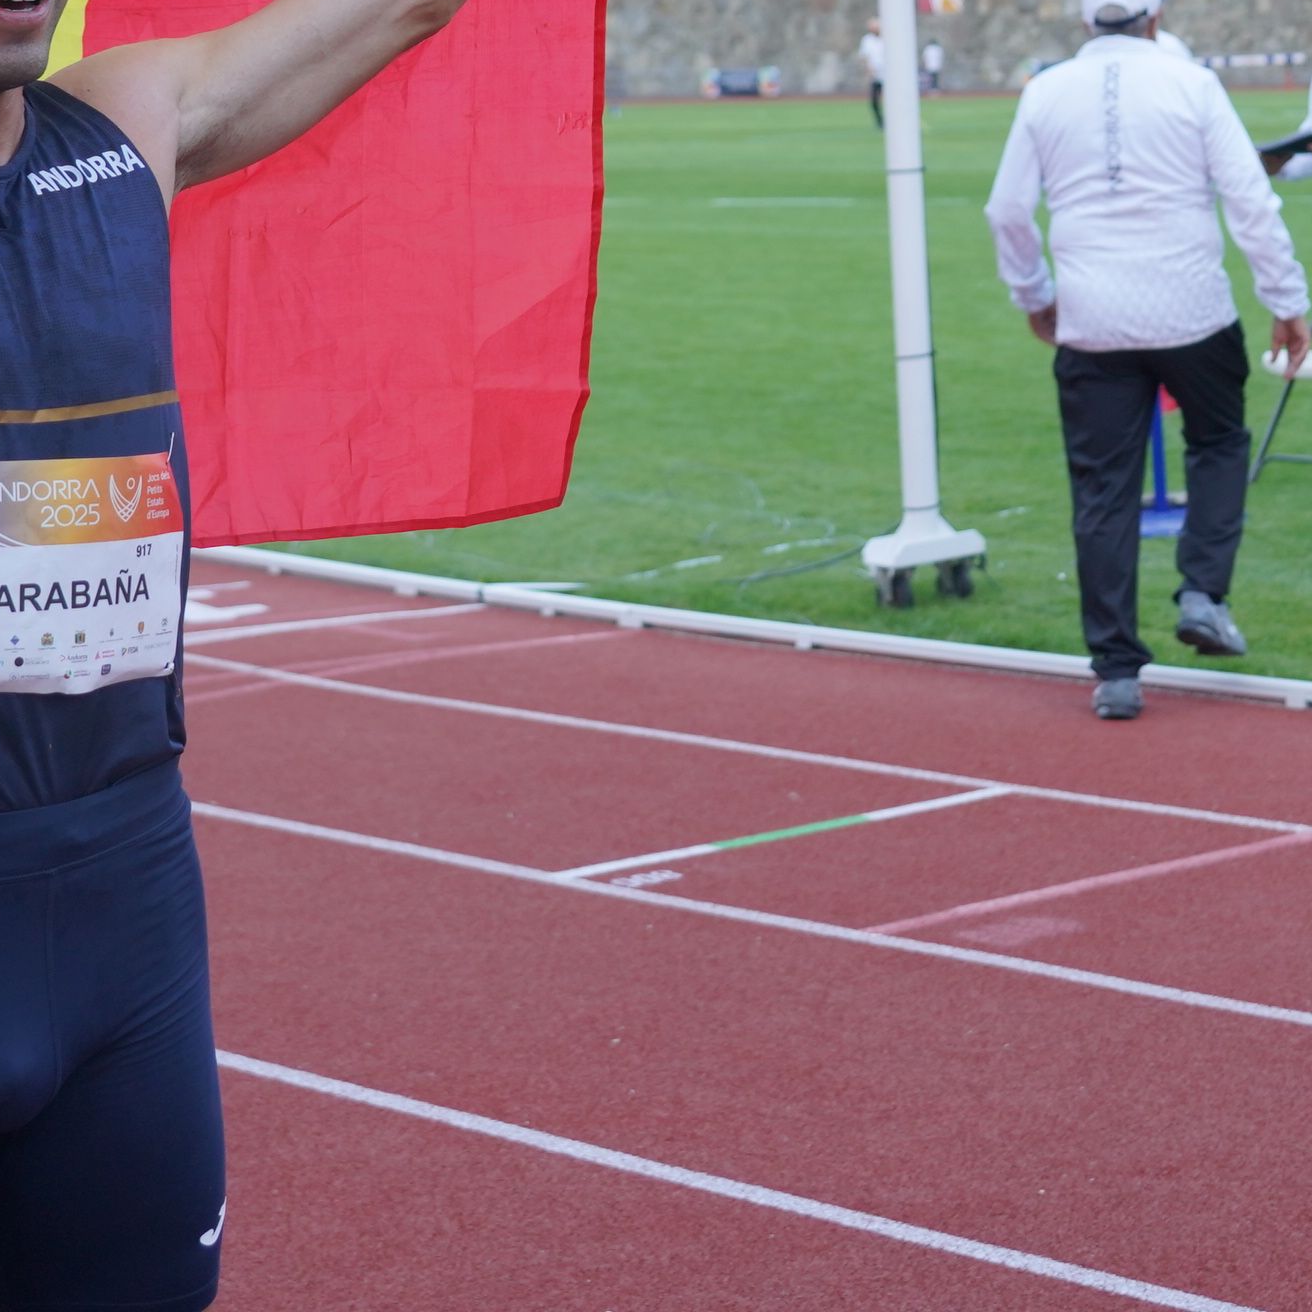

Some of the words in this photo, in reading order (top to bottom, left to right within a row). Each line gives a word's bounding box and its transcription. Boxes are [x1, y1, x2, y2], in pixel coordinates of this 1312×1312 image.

[27, 143, 145, 195] ANDORRA
[40, 503, 100, 528] 2025
[136, 543, 152, 557] 917
